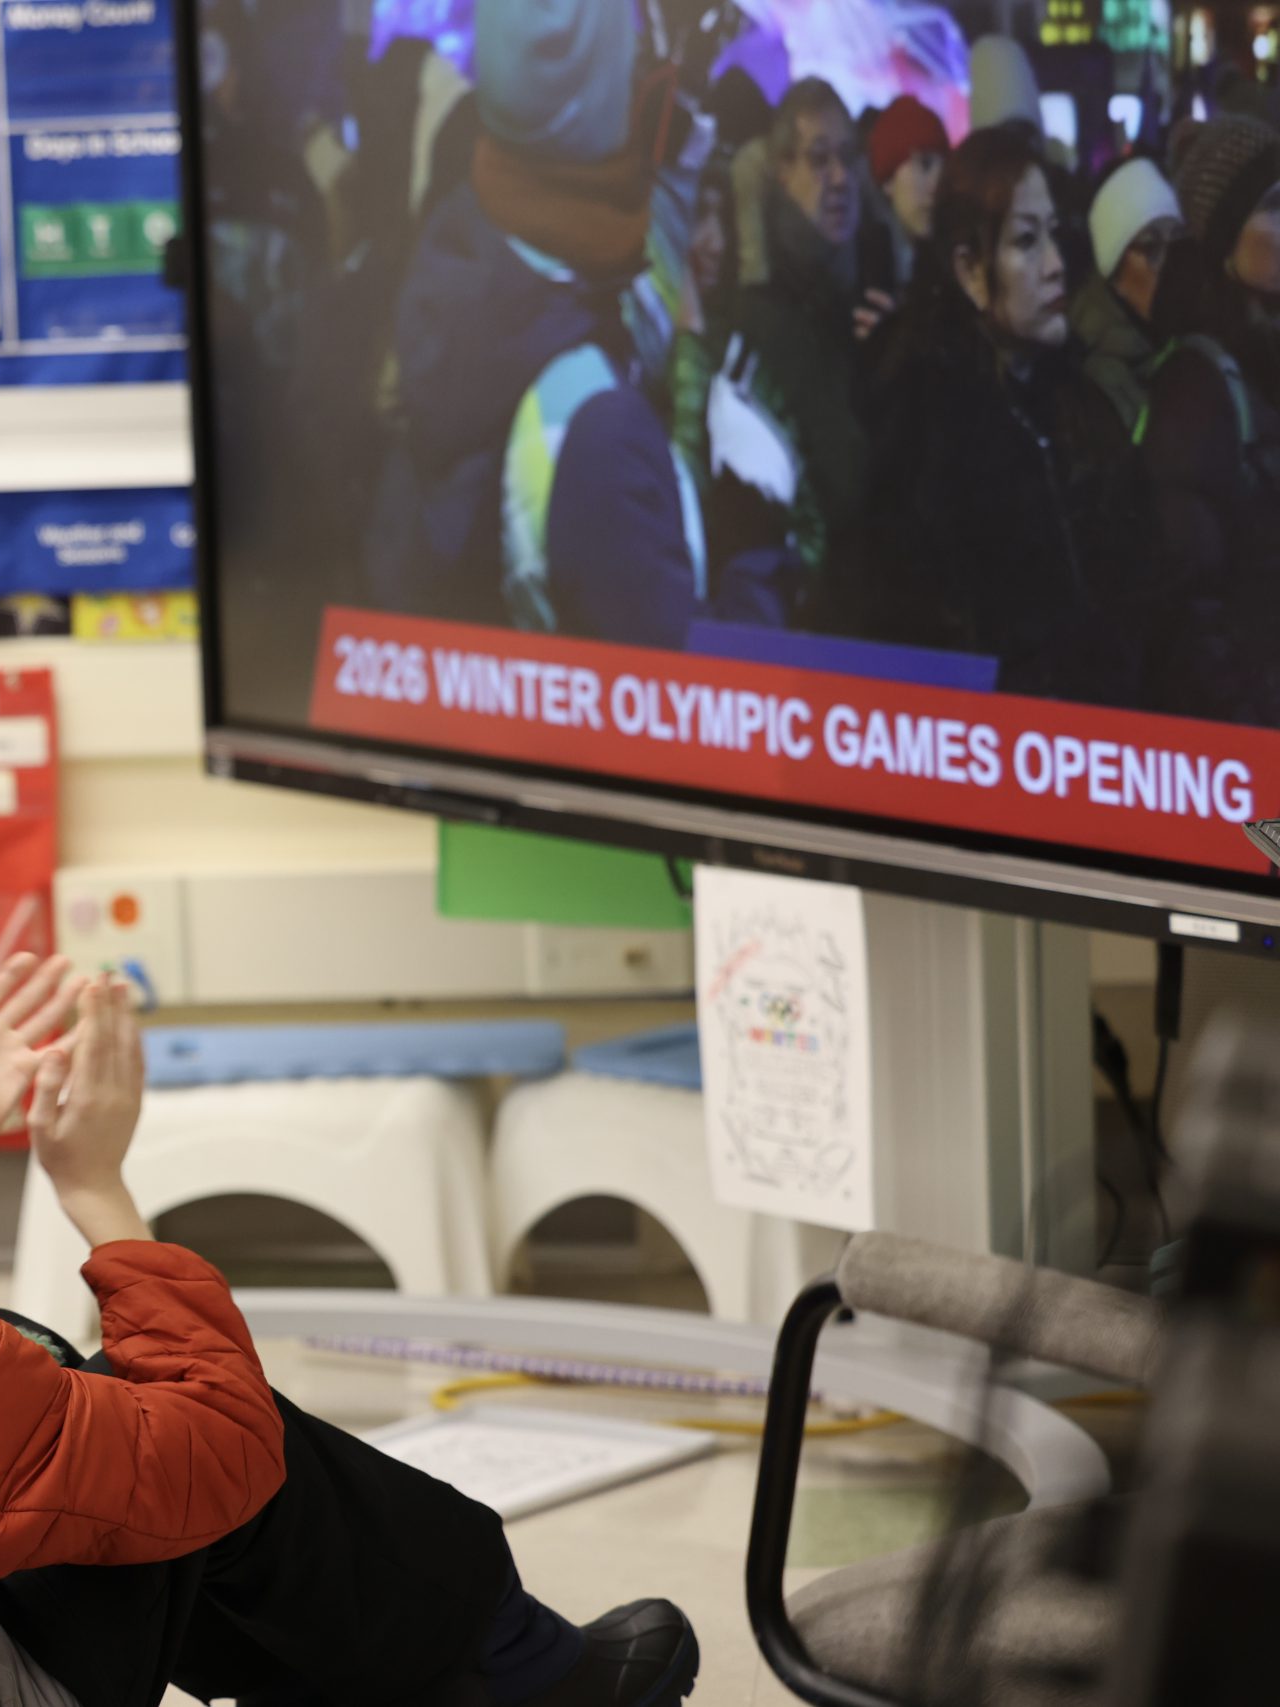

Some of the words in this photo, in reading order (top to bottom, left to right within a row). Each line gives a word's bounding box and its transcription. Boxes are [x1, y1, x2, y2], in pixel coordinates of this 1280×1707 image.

[335, 636, 427, 703] 2026
[432, 649, 603, 729] WINTER
[611, 674, 813, 761] OLYMPIC
[824, 704, 1002, 787] GAMES
[1014, 731, 1253, 823] OPENING
